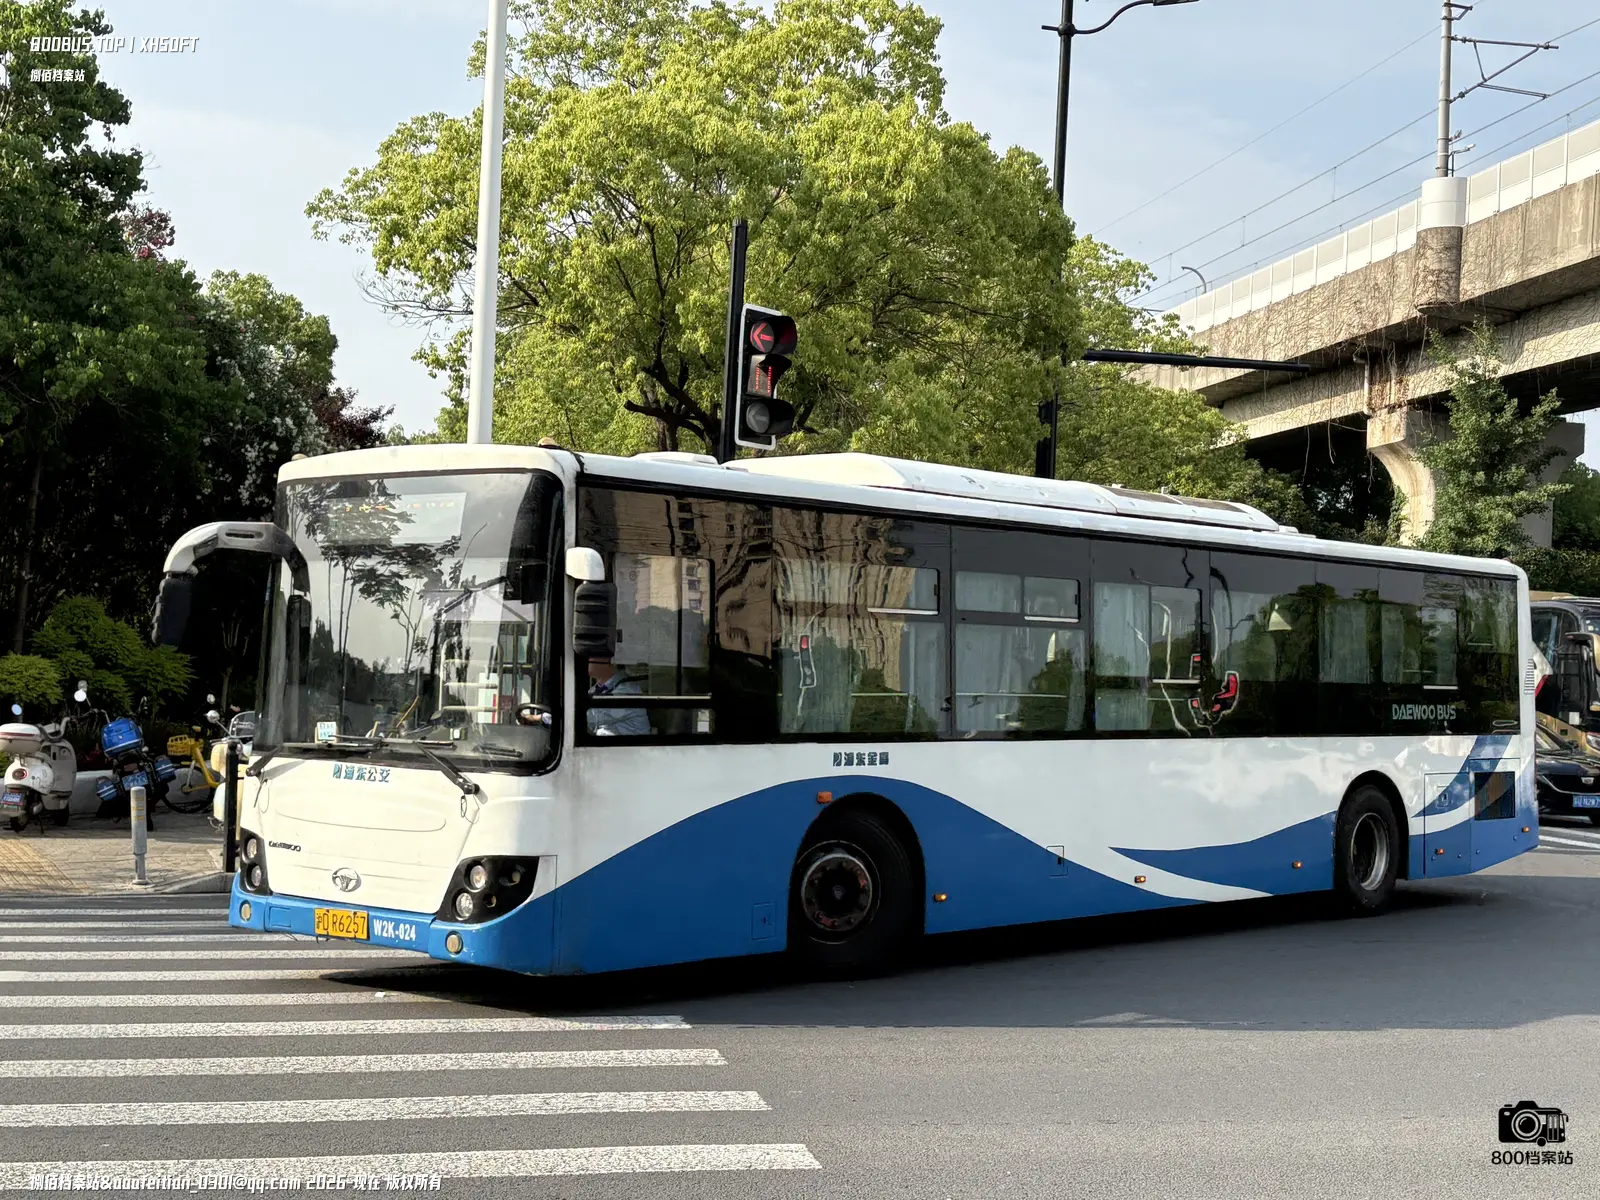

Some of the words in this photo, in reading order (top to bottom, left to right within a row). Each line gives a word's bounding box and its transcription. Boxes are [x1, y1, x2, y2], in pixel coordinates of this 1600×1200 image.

[1392, 703, 1436, 721] DAEWOO
[1437, 704, 1457, 720] BUS
[373, 918, 416, 942] W2K-024
